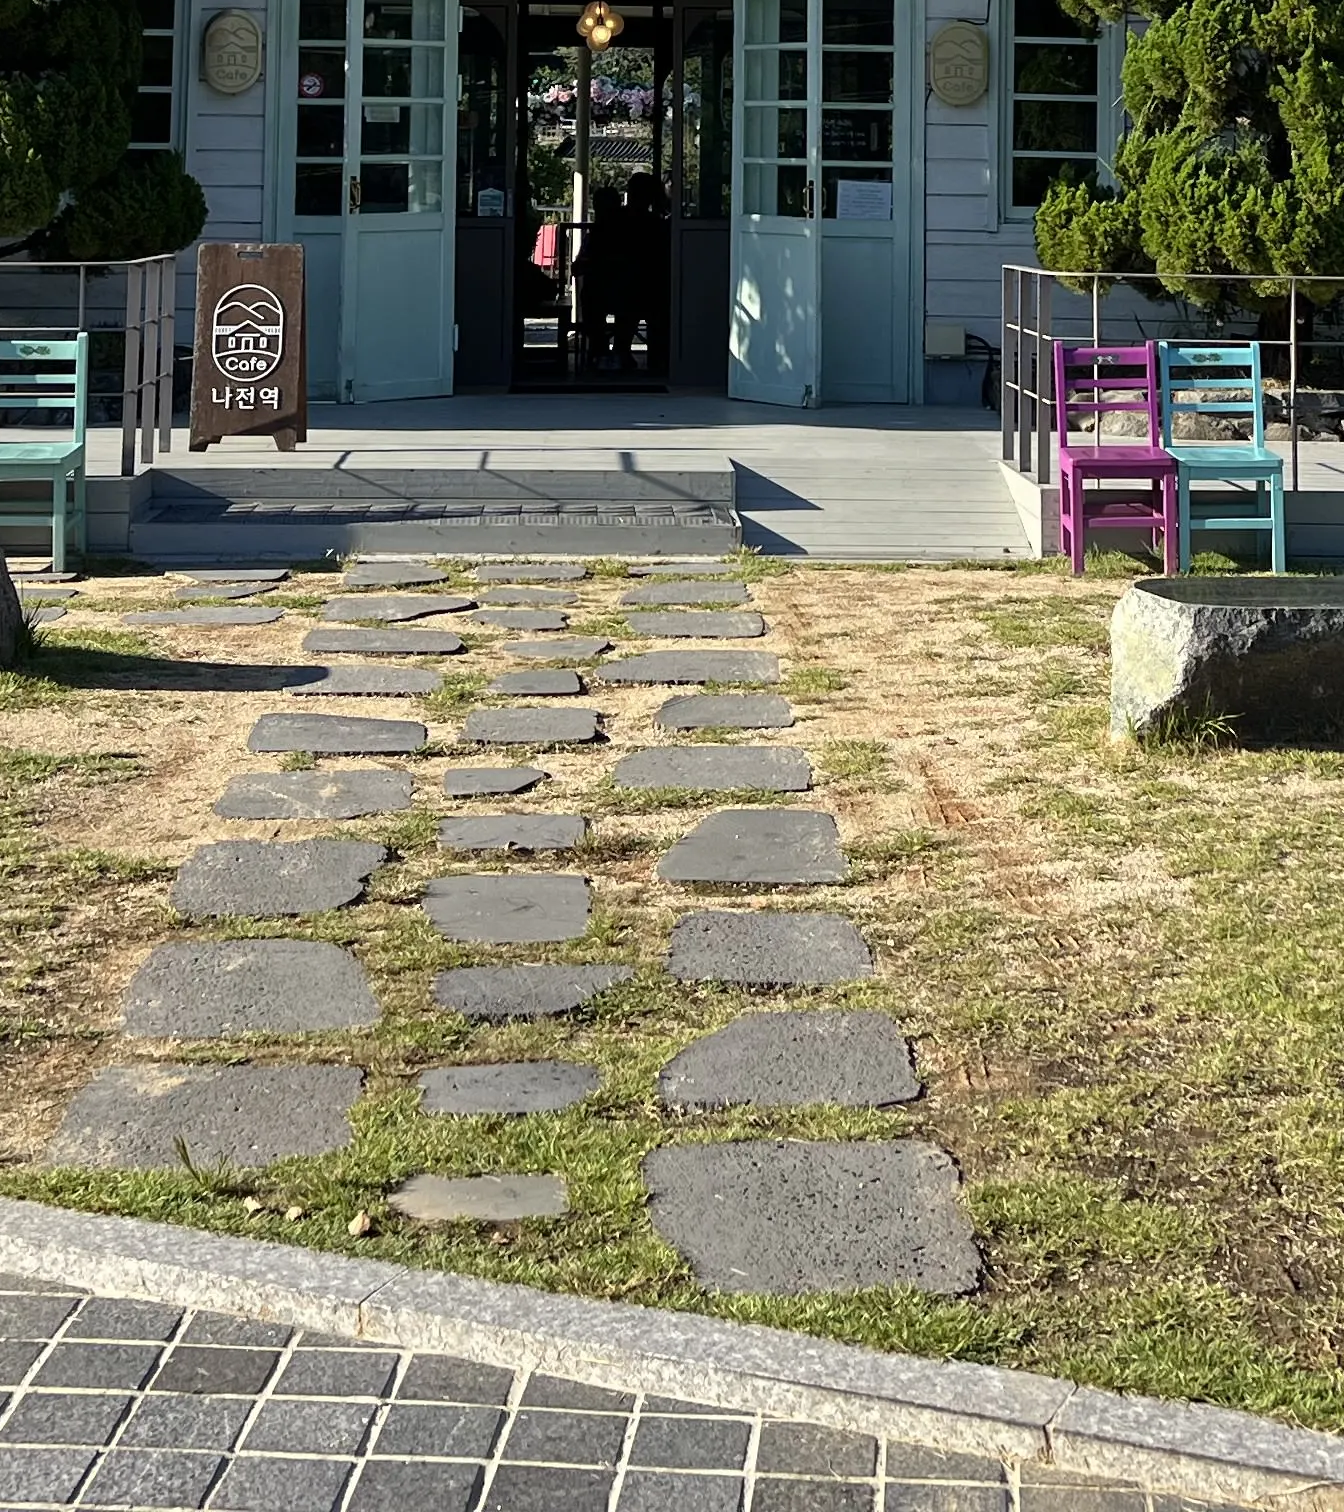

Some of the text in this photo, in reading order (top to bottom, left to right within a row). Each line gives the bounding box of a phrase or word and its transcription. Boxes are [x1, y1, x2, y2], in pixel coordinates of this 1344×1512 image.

[216, 68, 248, 81] Cafe
[942, 80, 974, 92] Cafe
[225, 356, 268, 371] Cafe
[211, 386, 279, 411] 나전역
